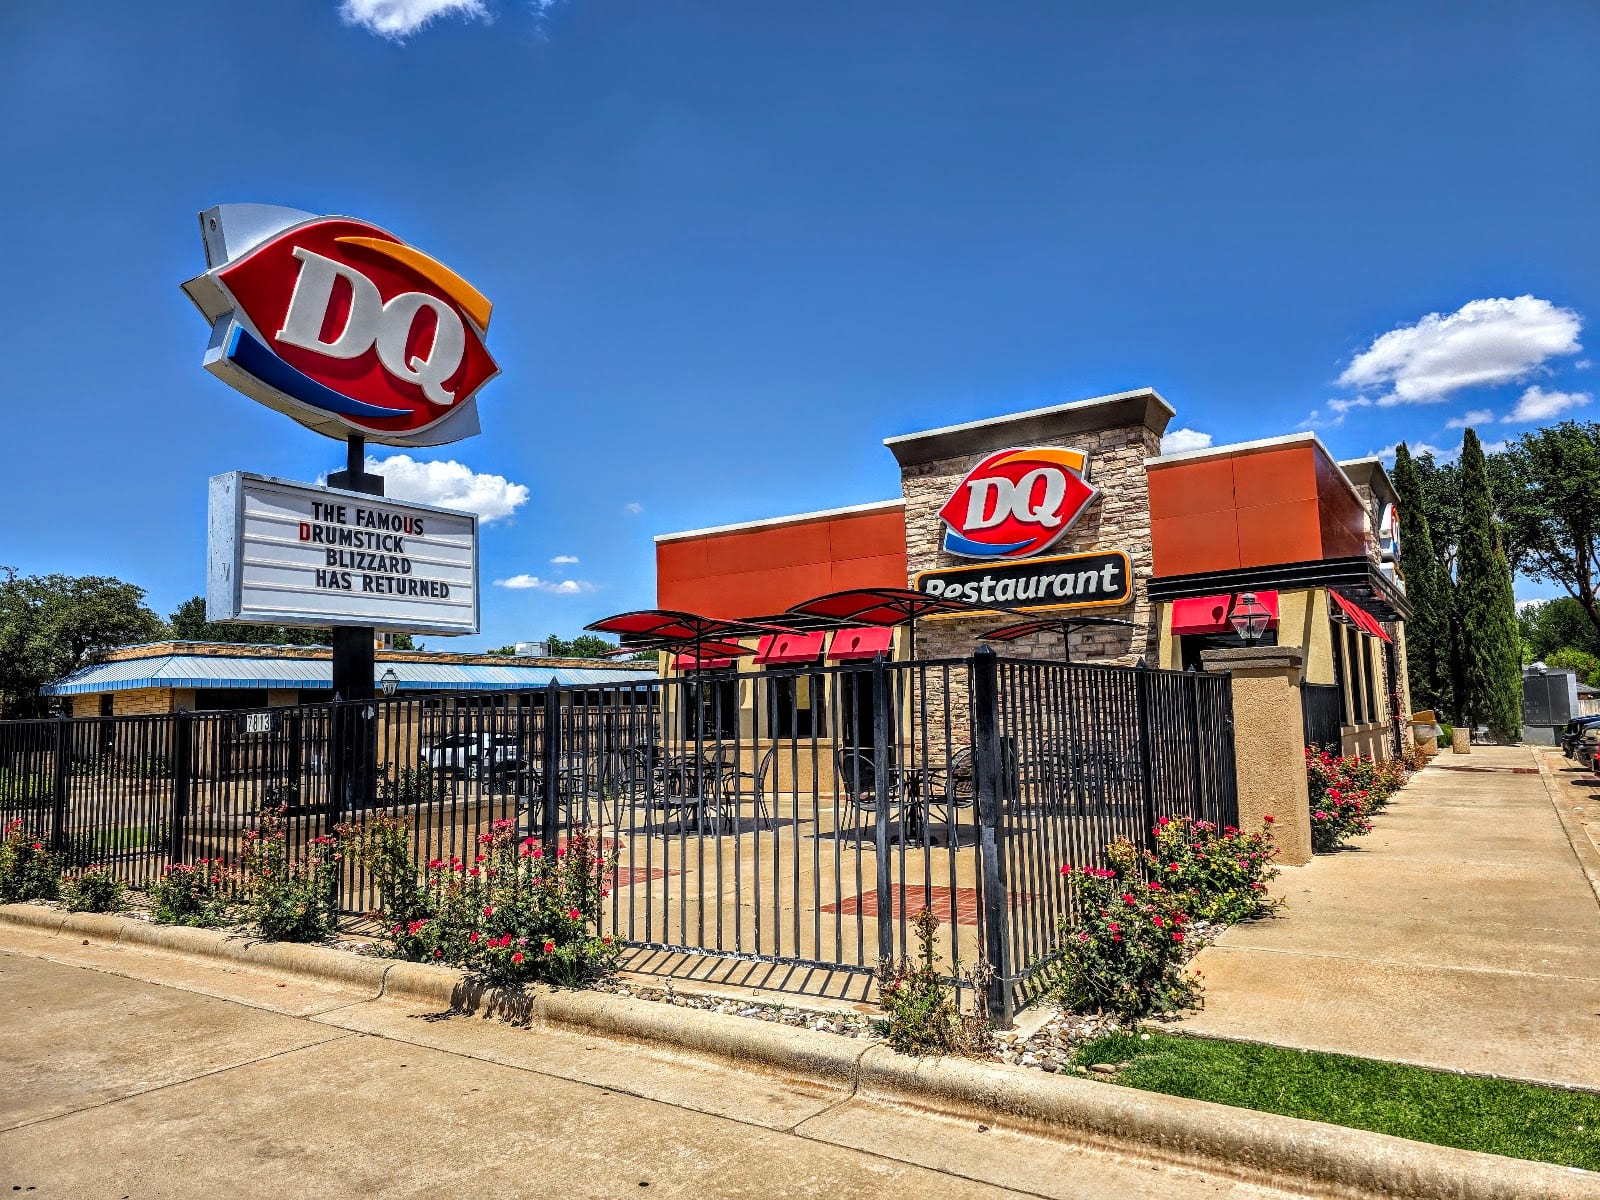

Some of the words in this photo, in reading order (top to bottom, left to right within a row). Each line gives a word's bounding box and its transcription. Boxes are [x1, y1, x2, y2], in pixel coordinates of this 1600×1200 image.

[275, 246, 466, 406] DQ
[962, 467, 1067, 531] DQ
[311, 501, 346, 525] THE
[356, 508, 424, 536] FAMOUS
[299, 522, 405, 554] DRUMSTICK
[326, 548, 412, 575] BLIZZARD
[316, 569, 351, 590] HAS
[362, 574, 450, 599] RETURNED
[925, 563, 1120, 604] Restaurant
